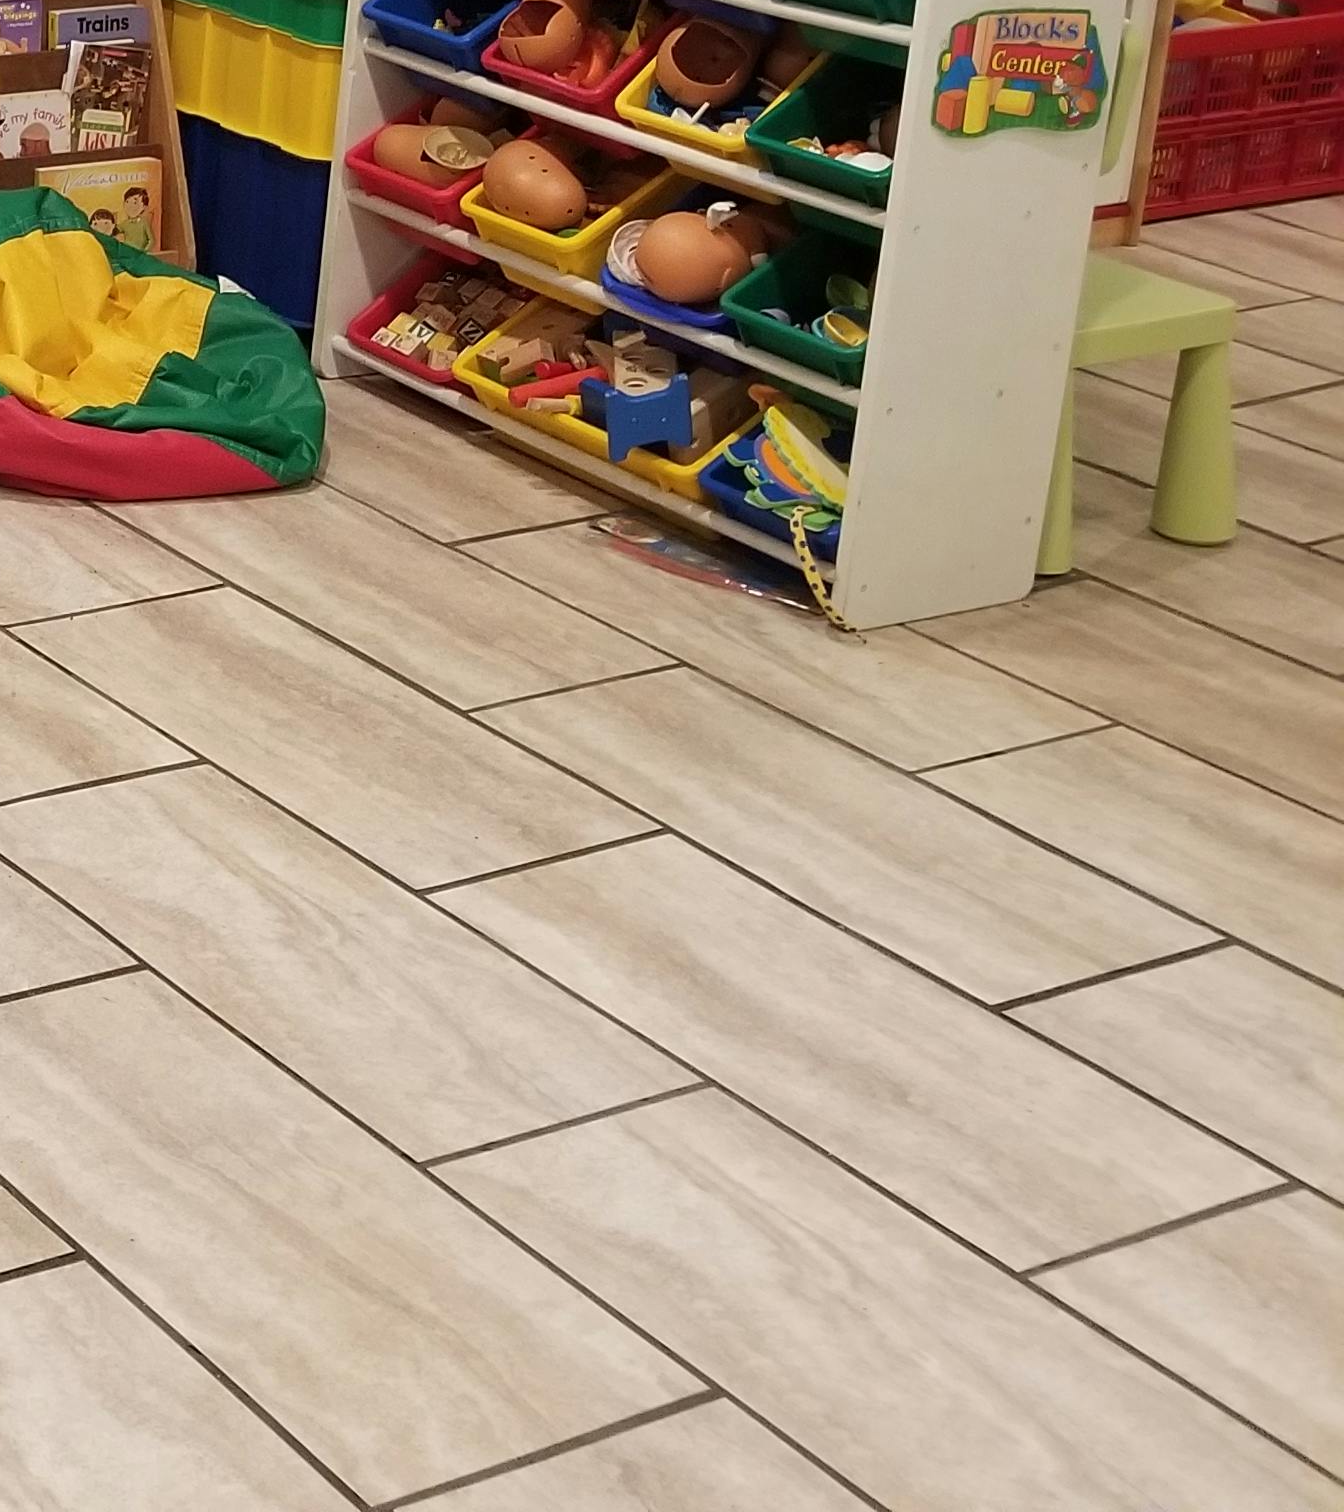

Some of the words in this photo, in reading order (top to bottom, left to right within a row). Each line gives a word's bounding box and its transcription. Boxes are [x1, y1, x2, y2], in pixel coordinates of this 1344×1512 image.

[76, 13, 131, 35] Trains
[995, 16, 1080, 42] Blocks
[990, 48, 1066, 77] Center
